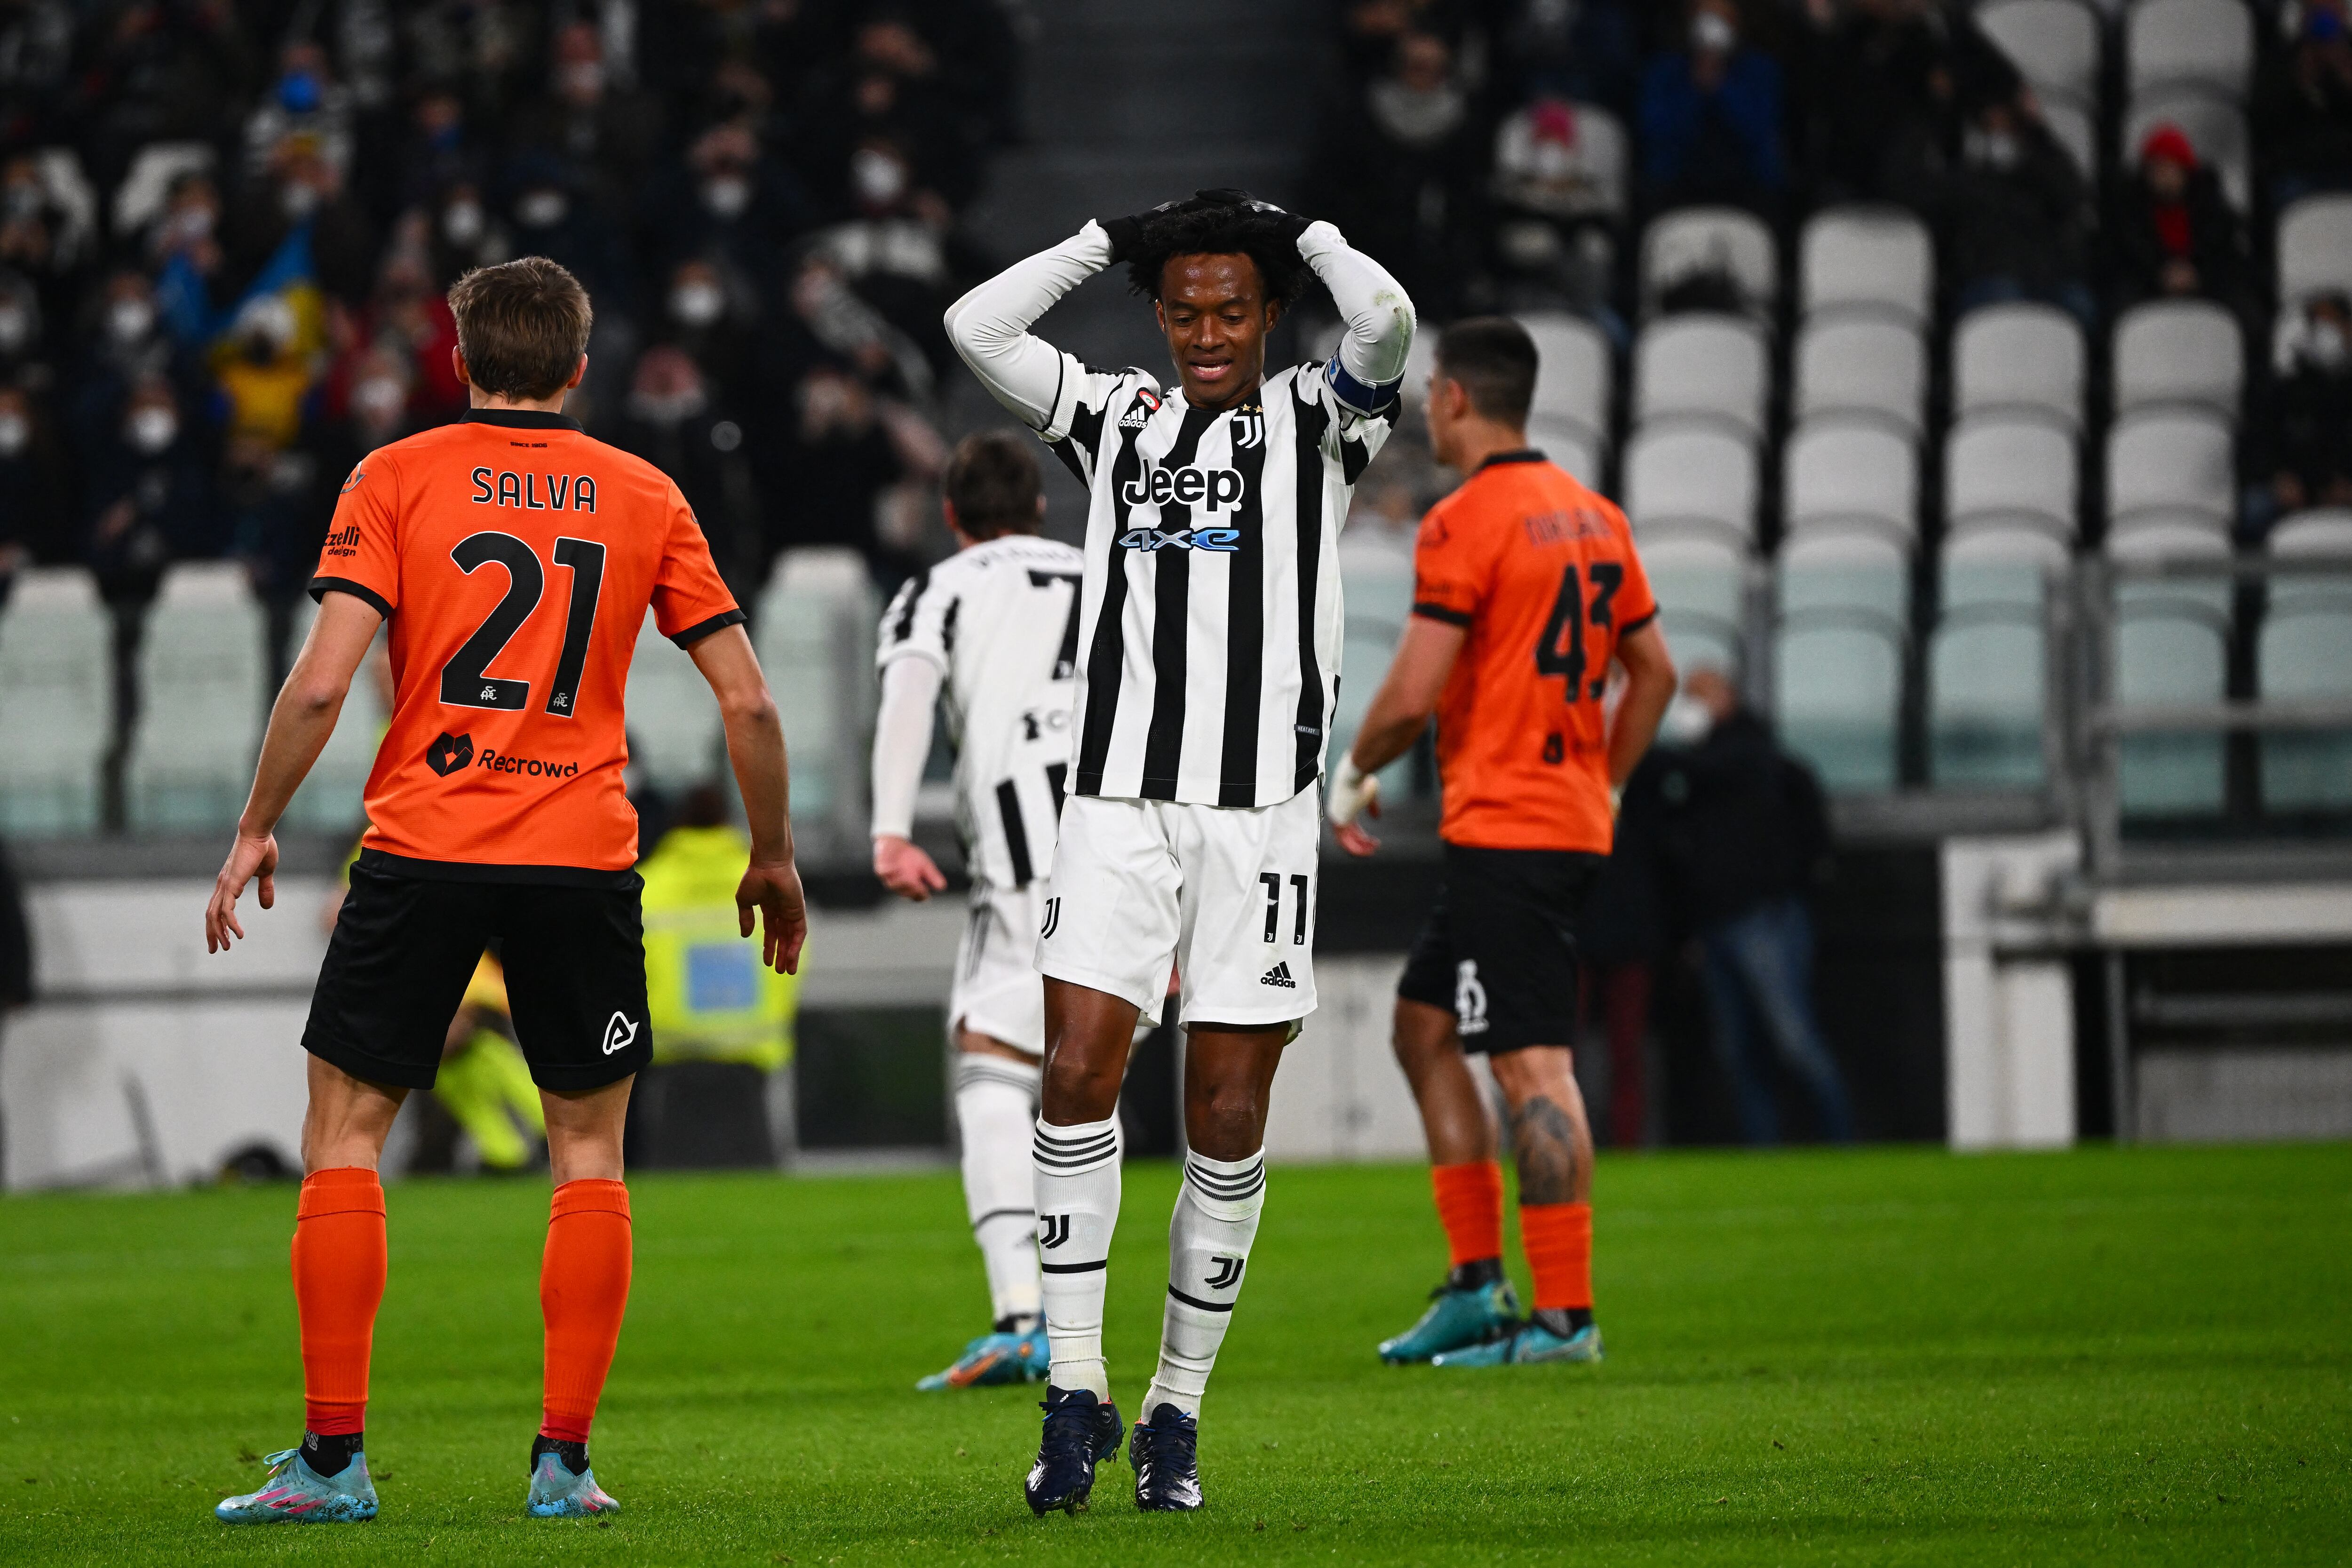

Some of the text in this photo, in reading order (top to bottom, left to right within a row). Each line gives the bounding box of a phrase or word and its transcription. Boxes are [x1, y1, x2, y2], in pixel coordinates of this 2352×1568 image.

[1119, 419, 1148, 429] adidas
[471, 467, 596, 514] SALVA
[1122, 459, 1244, 514] Jeep
[328, 546, 356, 557] design
[440, 531, 606, 719] 21
[477, 748, 579, 778] Recrowd
[1259, 872, 1308, 946] 11
[1261, 976, 1295, 988] adidas
